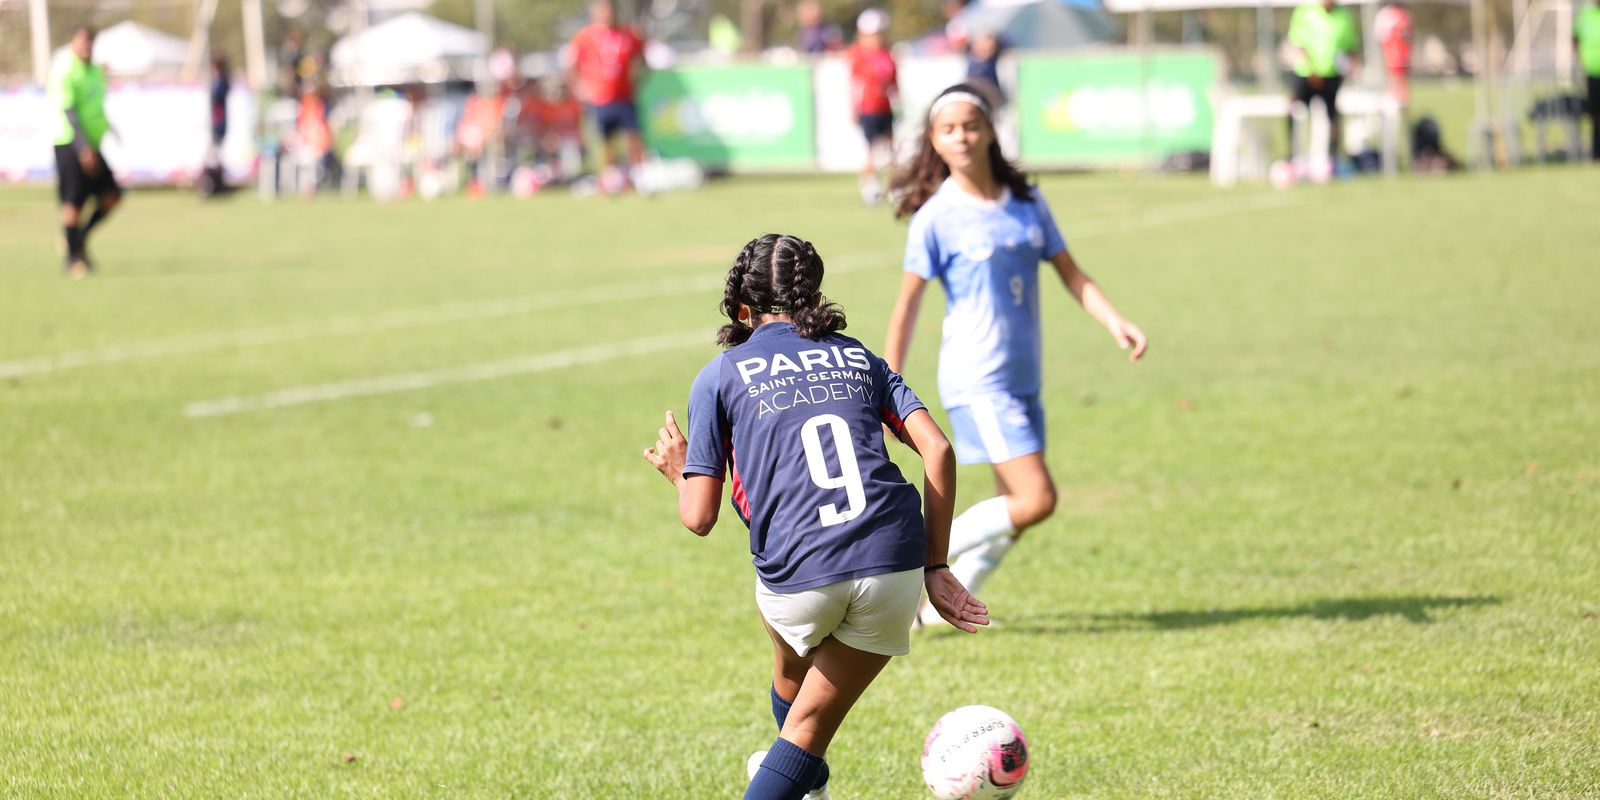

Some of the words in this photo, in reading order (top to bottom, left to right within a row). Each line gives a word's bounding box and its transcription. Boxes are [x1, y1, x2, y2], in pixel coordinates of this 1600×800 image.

[1009, 274, 1026, 306] 9
[736, 346, 871, 385] PARIS
[758, 383, 874, 420] ACADEMY
[801, 413, 867, 527] 9
[972, 720, 1005, 738] SUPER
